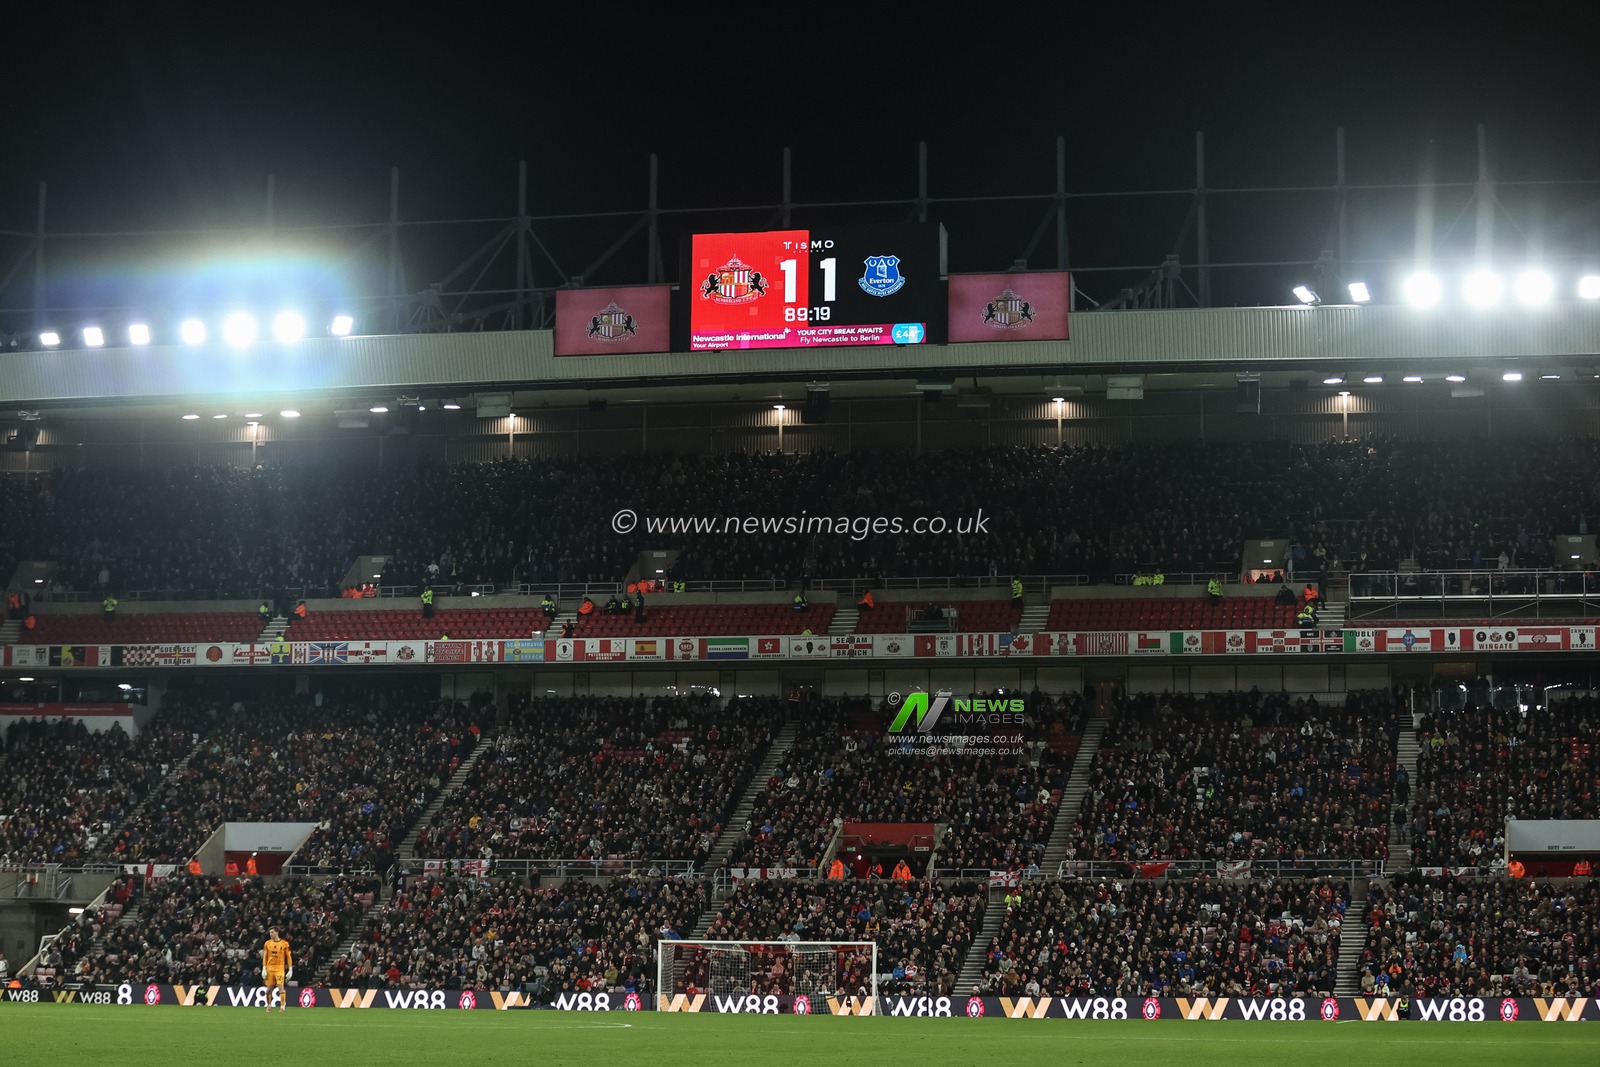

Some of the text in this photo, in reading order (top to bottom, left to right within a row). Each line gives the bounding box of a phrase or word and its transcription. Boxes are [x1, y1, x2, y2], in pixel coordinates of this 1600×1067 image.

[783, 240, 834, 250] TISMO
[780, 259, 797, 303] 1
[820, 257, 837, 302] 1
[784, 306, 831, 322] 89:19
[692, 332, 786, 343] Newcastle International
[800, 337, 811, 345] Fly
[815, 335, 849, 343] Newcastle
[8, 989, 39, 1003] W88
[79, 992, 111, 1004] W88
[384, 990, 446, 1009] W88
[550, 992, 610, 1011] W88
[714, 994, 779, 1014] W88
[885, 996, 952, 1017] W88
[1060, 997, 1128, 1020] W88
[1237, 998, 1306, 1021] W88
[1415, 997, 1486, 1022] W88
